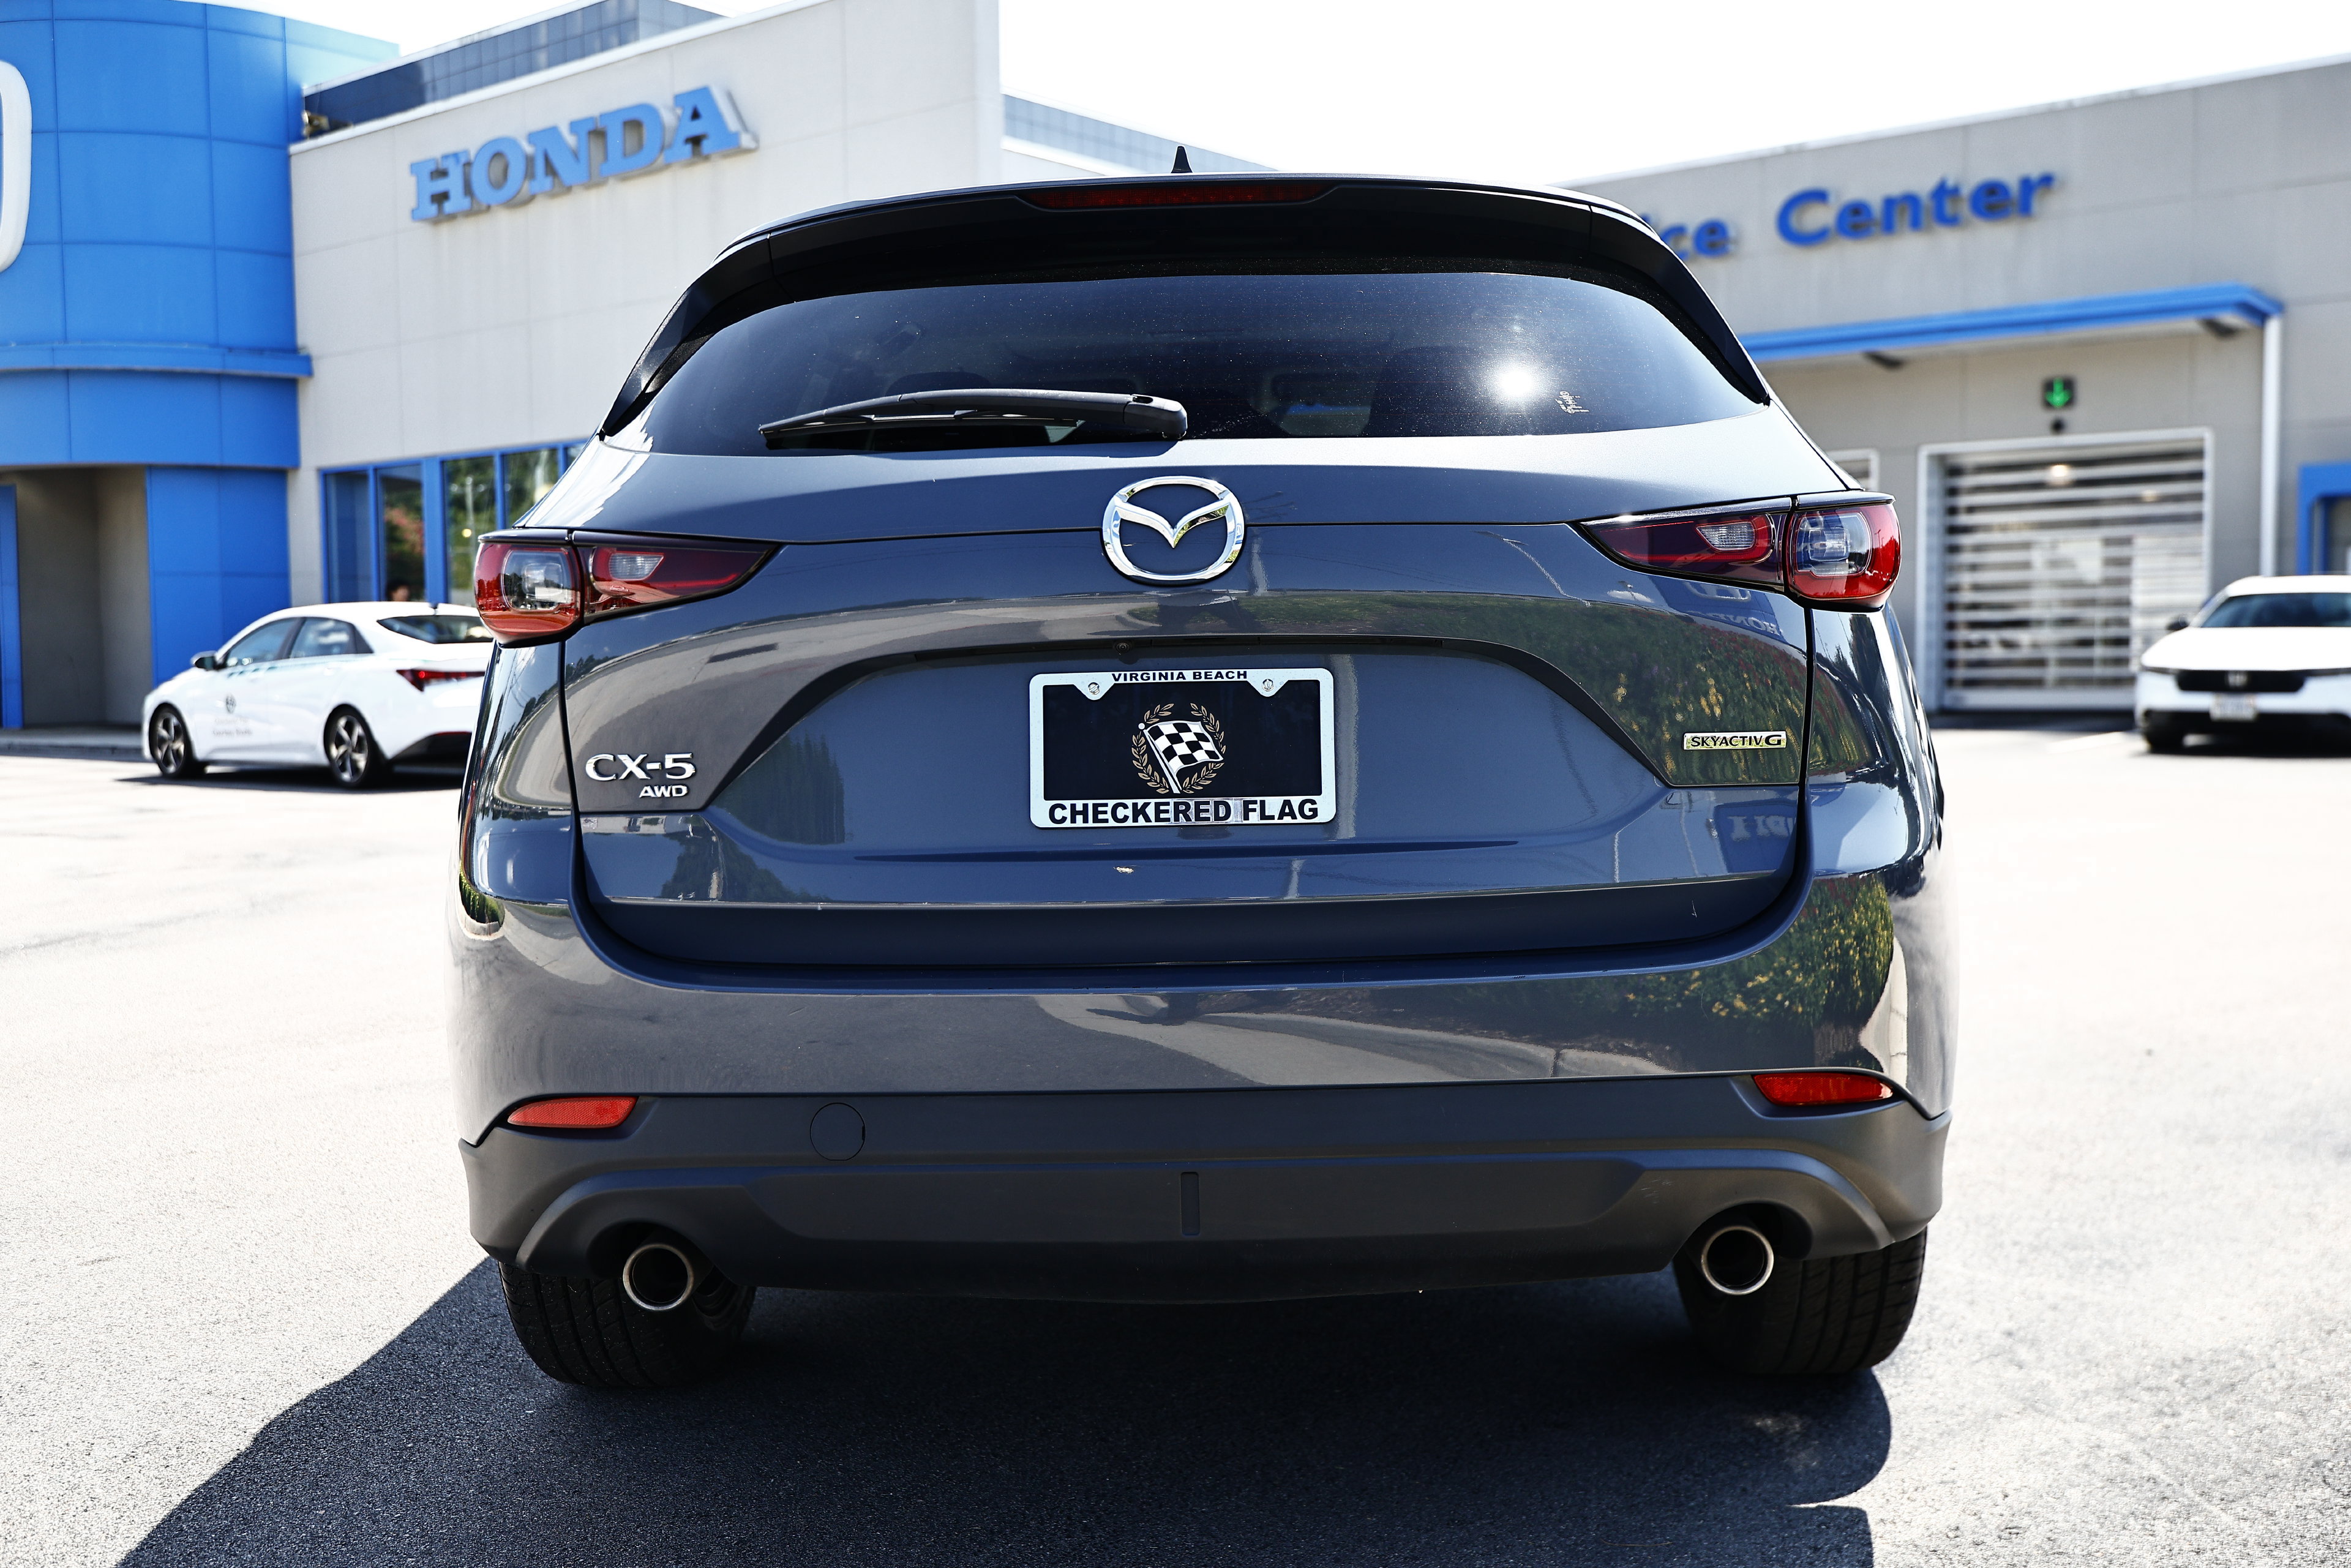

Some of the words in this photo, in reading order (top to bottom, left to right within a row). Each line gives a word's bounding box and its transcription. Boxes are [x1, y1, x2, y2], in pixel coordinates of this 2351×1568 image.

[410, 84, 748, 223] HONDA
[1638, 213, 1730, 261] ce
[1777, 172, 2055, 247] Center
[1112, 672, 1186, 682] VIRGINIA
[1193, 670, 1248, 681] BEACH
[585, 752, 696, 781] CX-5
[639, 784, 688, 798] AWD
[1048, 800, 1232, 825] CHECKERED
[1242, 798, 1319, 822] FLAG
